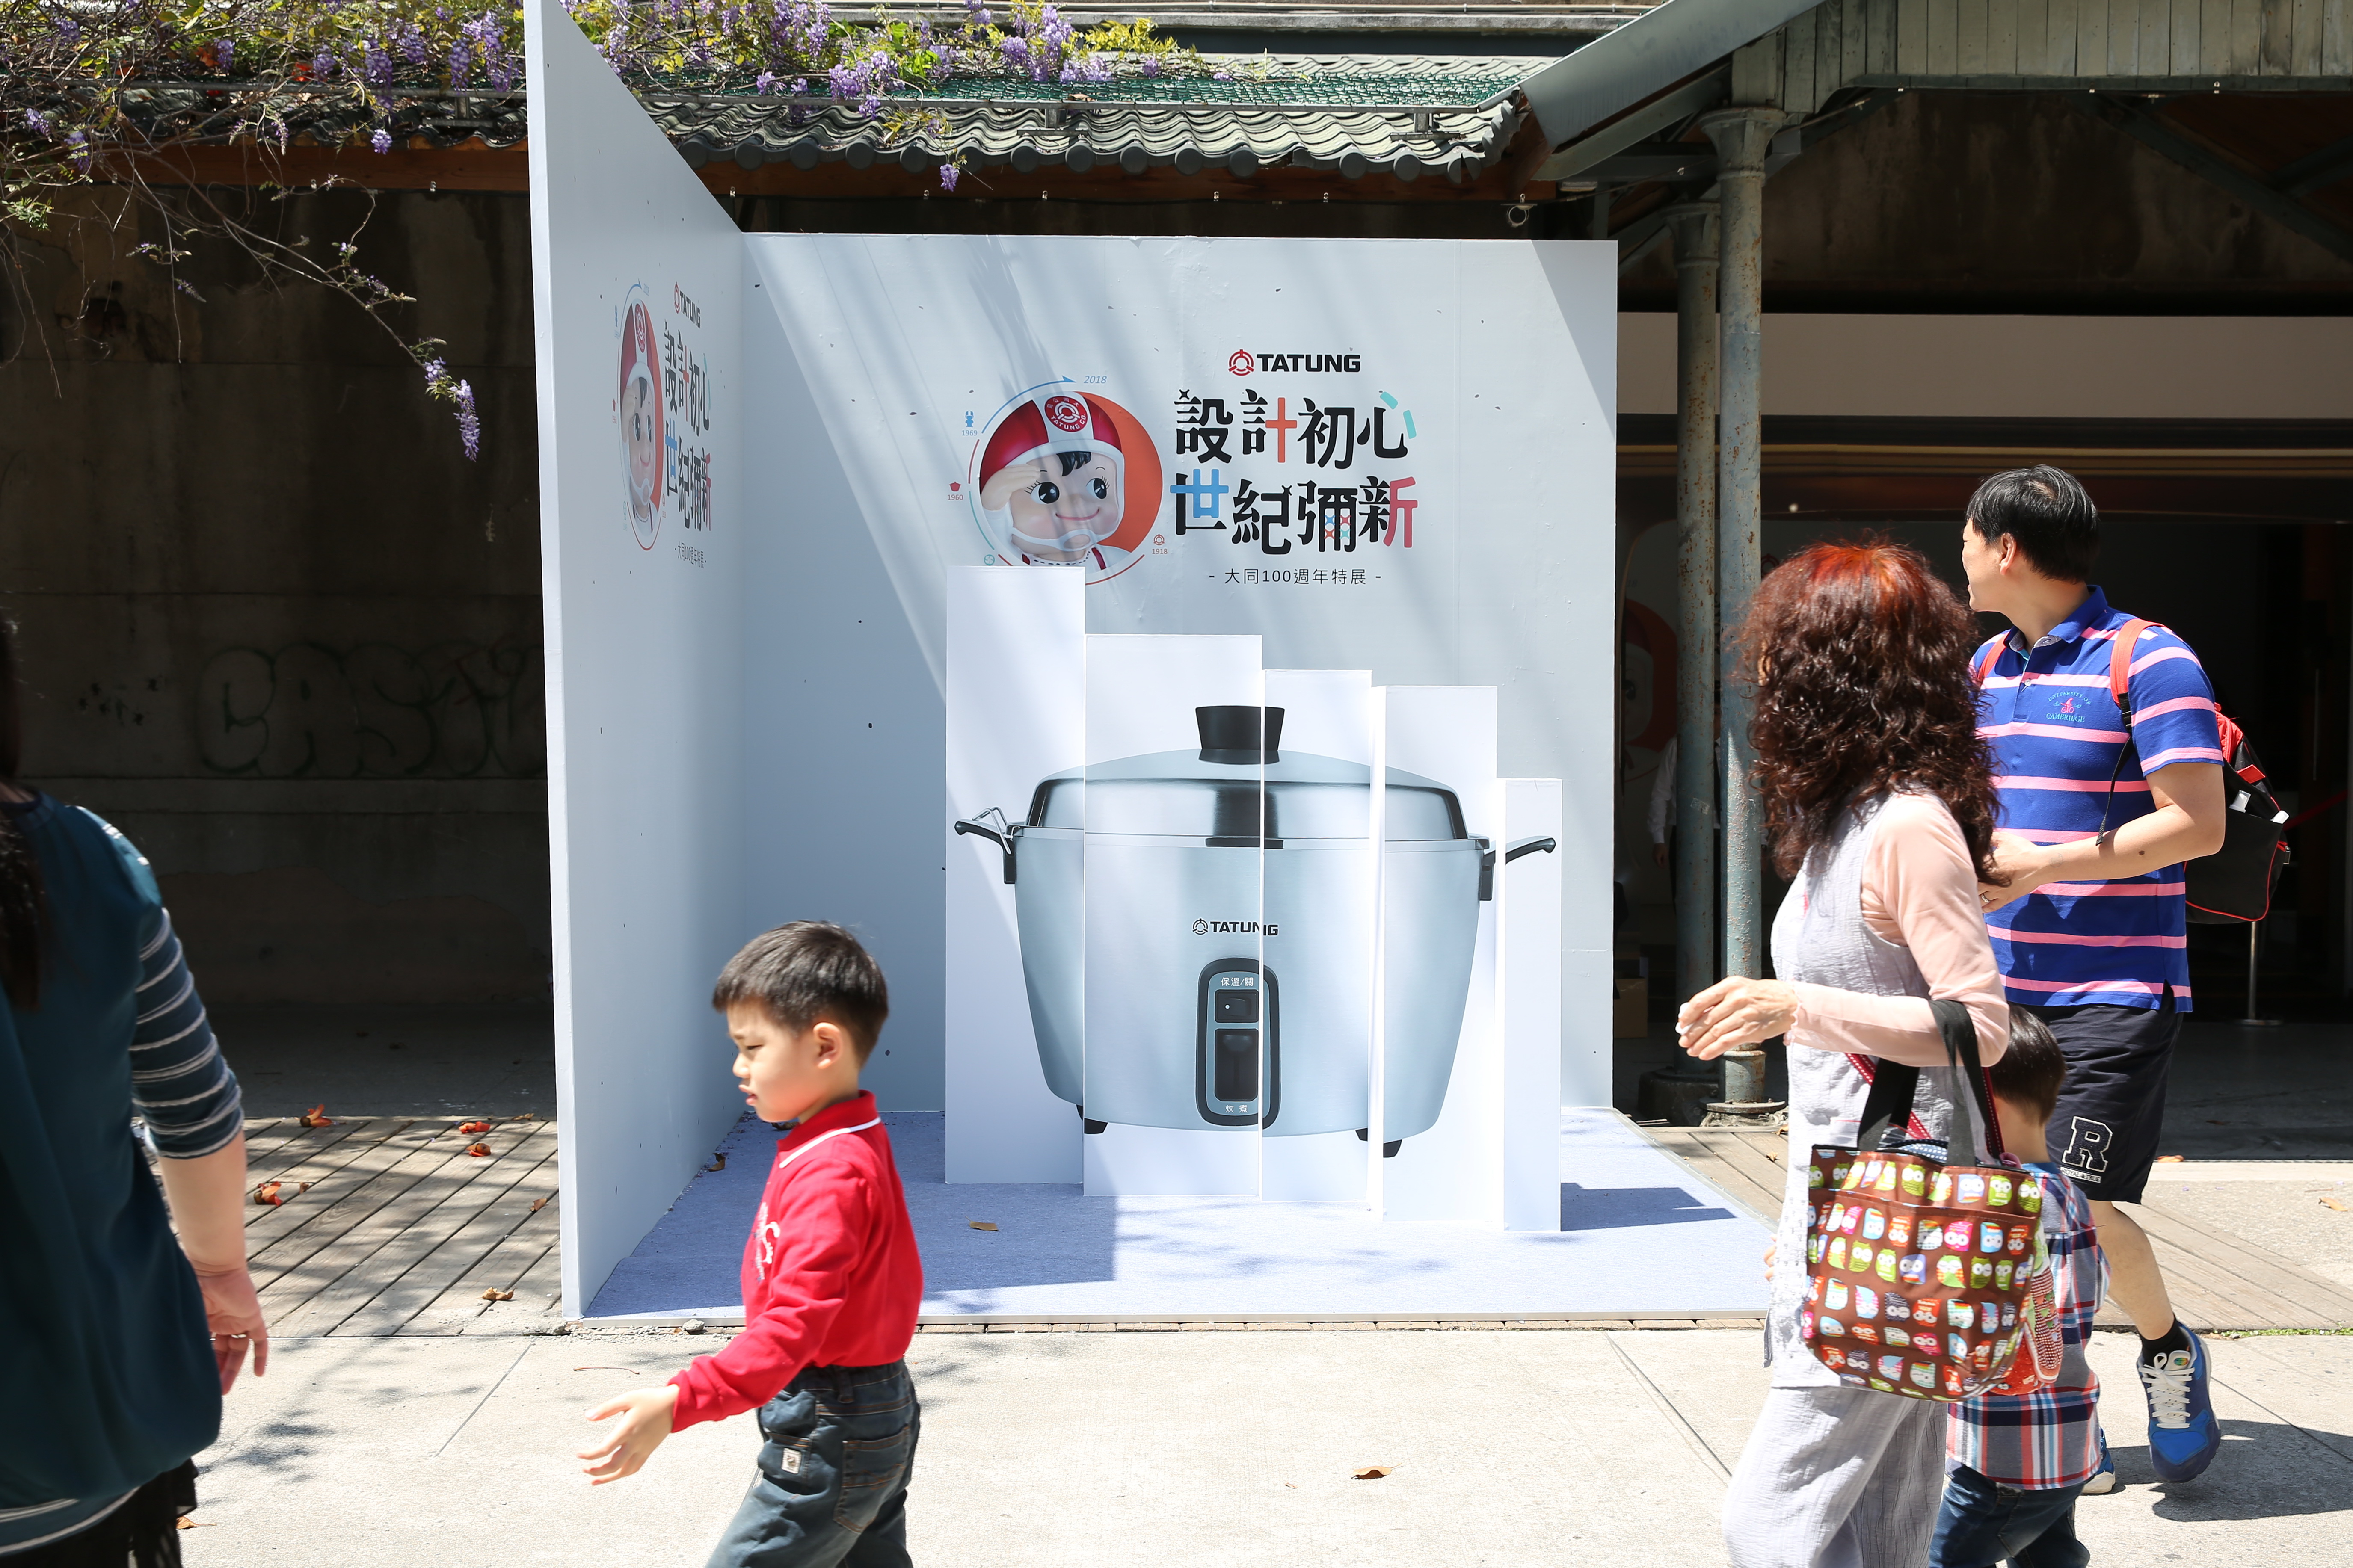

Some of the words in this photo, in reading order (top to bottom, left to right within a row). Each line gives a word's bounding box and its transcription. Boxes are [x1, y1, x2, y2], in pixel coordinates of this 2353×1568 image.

[679, 290, 701, 329] TATUNG
[1257, 354, 1361, 372] TATUNG
[664, 319, 711, 436] 設計初心
[1084, 376, 1107, 384] 2018
[1051, 415, 1080, 430] TATUNG
[1174, 388, 1417, 469] 設計初心
[665, 417, 711, 531] 世紀彌新
[1170, 468, 1418, 555] 世紀彌新
[2048, 691, 2083, 702] UNIVERSITY
[1210, 921, 1278, 936] TATUNG
[1221, 977, 1254, 987] 保溫/關
[2062, 1116, 2113, 1172] R
